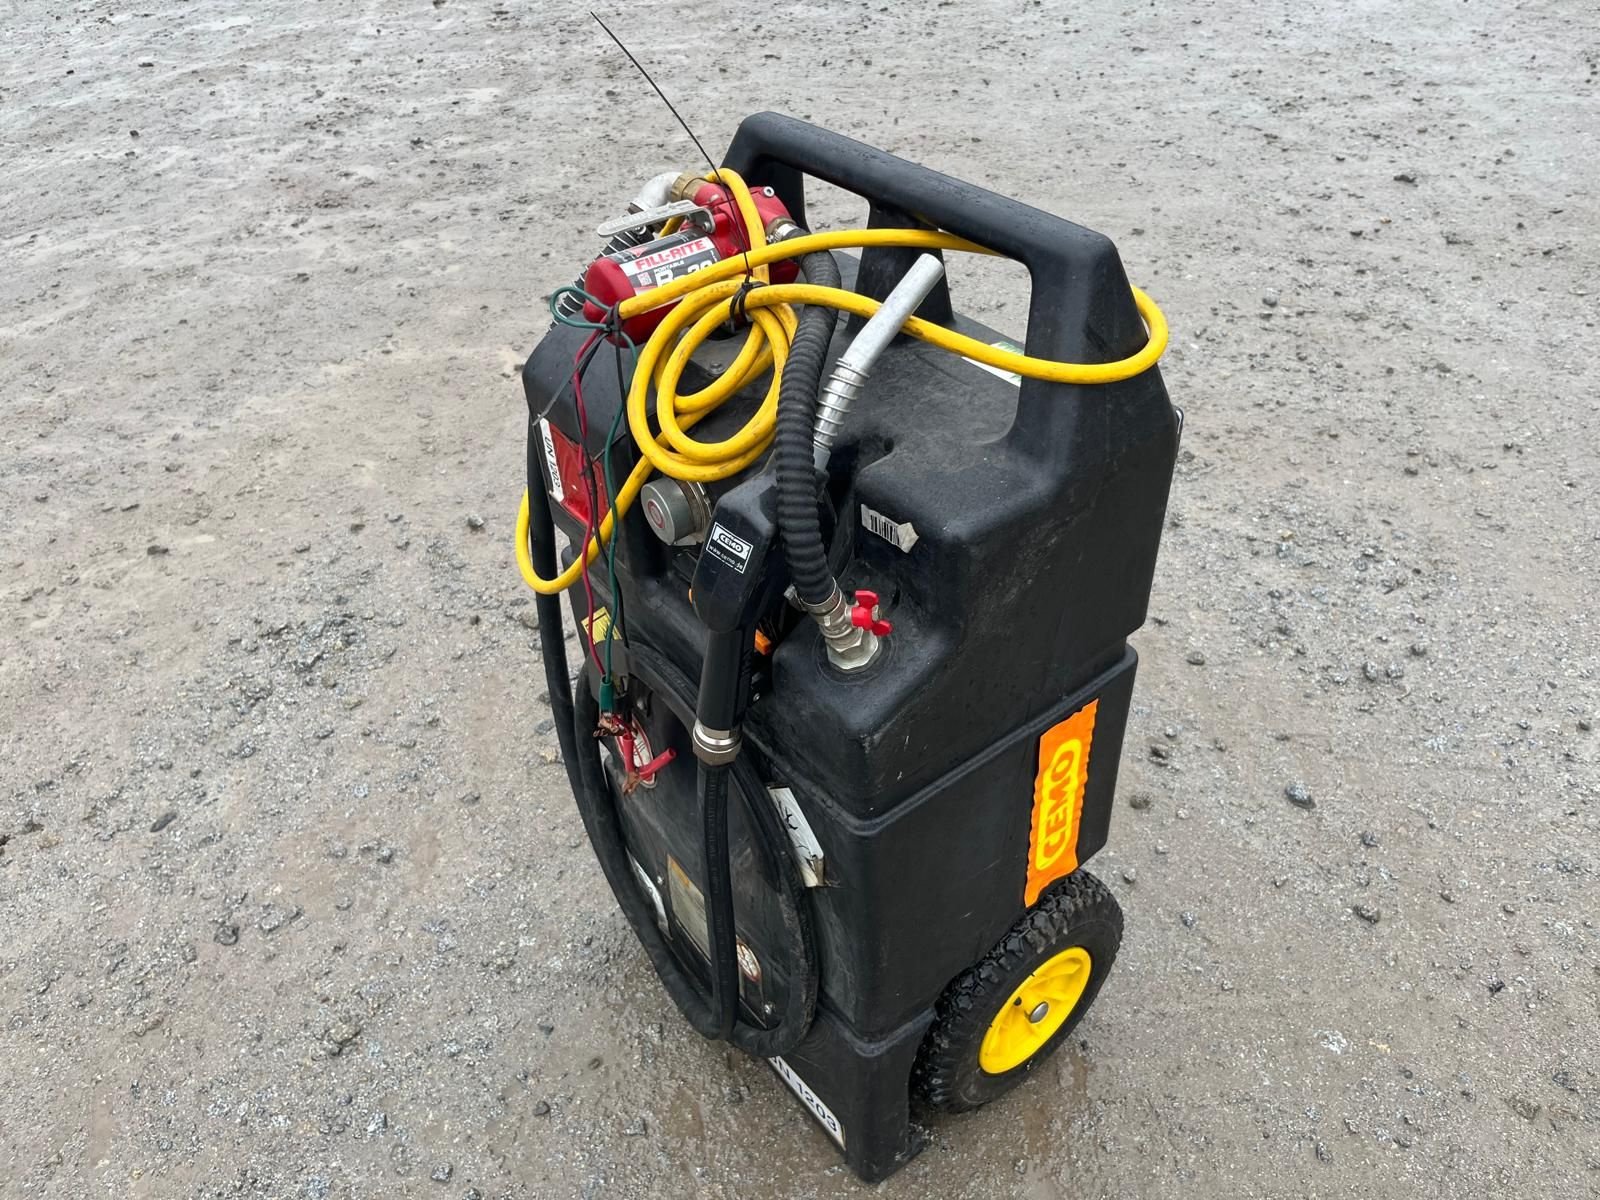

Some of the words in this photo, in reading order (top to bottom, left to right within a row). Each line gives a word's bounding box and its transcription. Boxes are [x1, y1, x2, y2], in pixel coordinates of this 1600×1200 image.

[635, 240, 706, 270] FILL-RITE
[545, 437, 554, 458] UN
[549, 461, 561, 487] 1203
[720, 534, 742, 552] CEMO
[1043, 750, 1075, 858] CEMO
[796, 1081, 837, 1132] 1203
